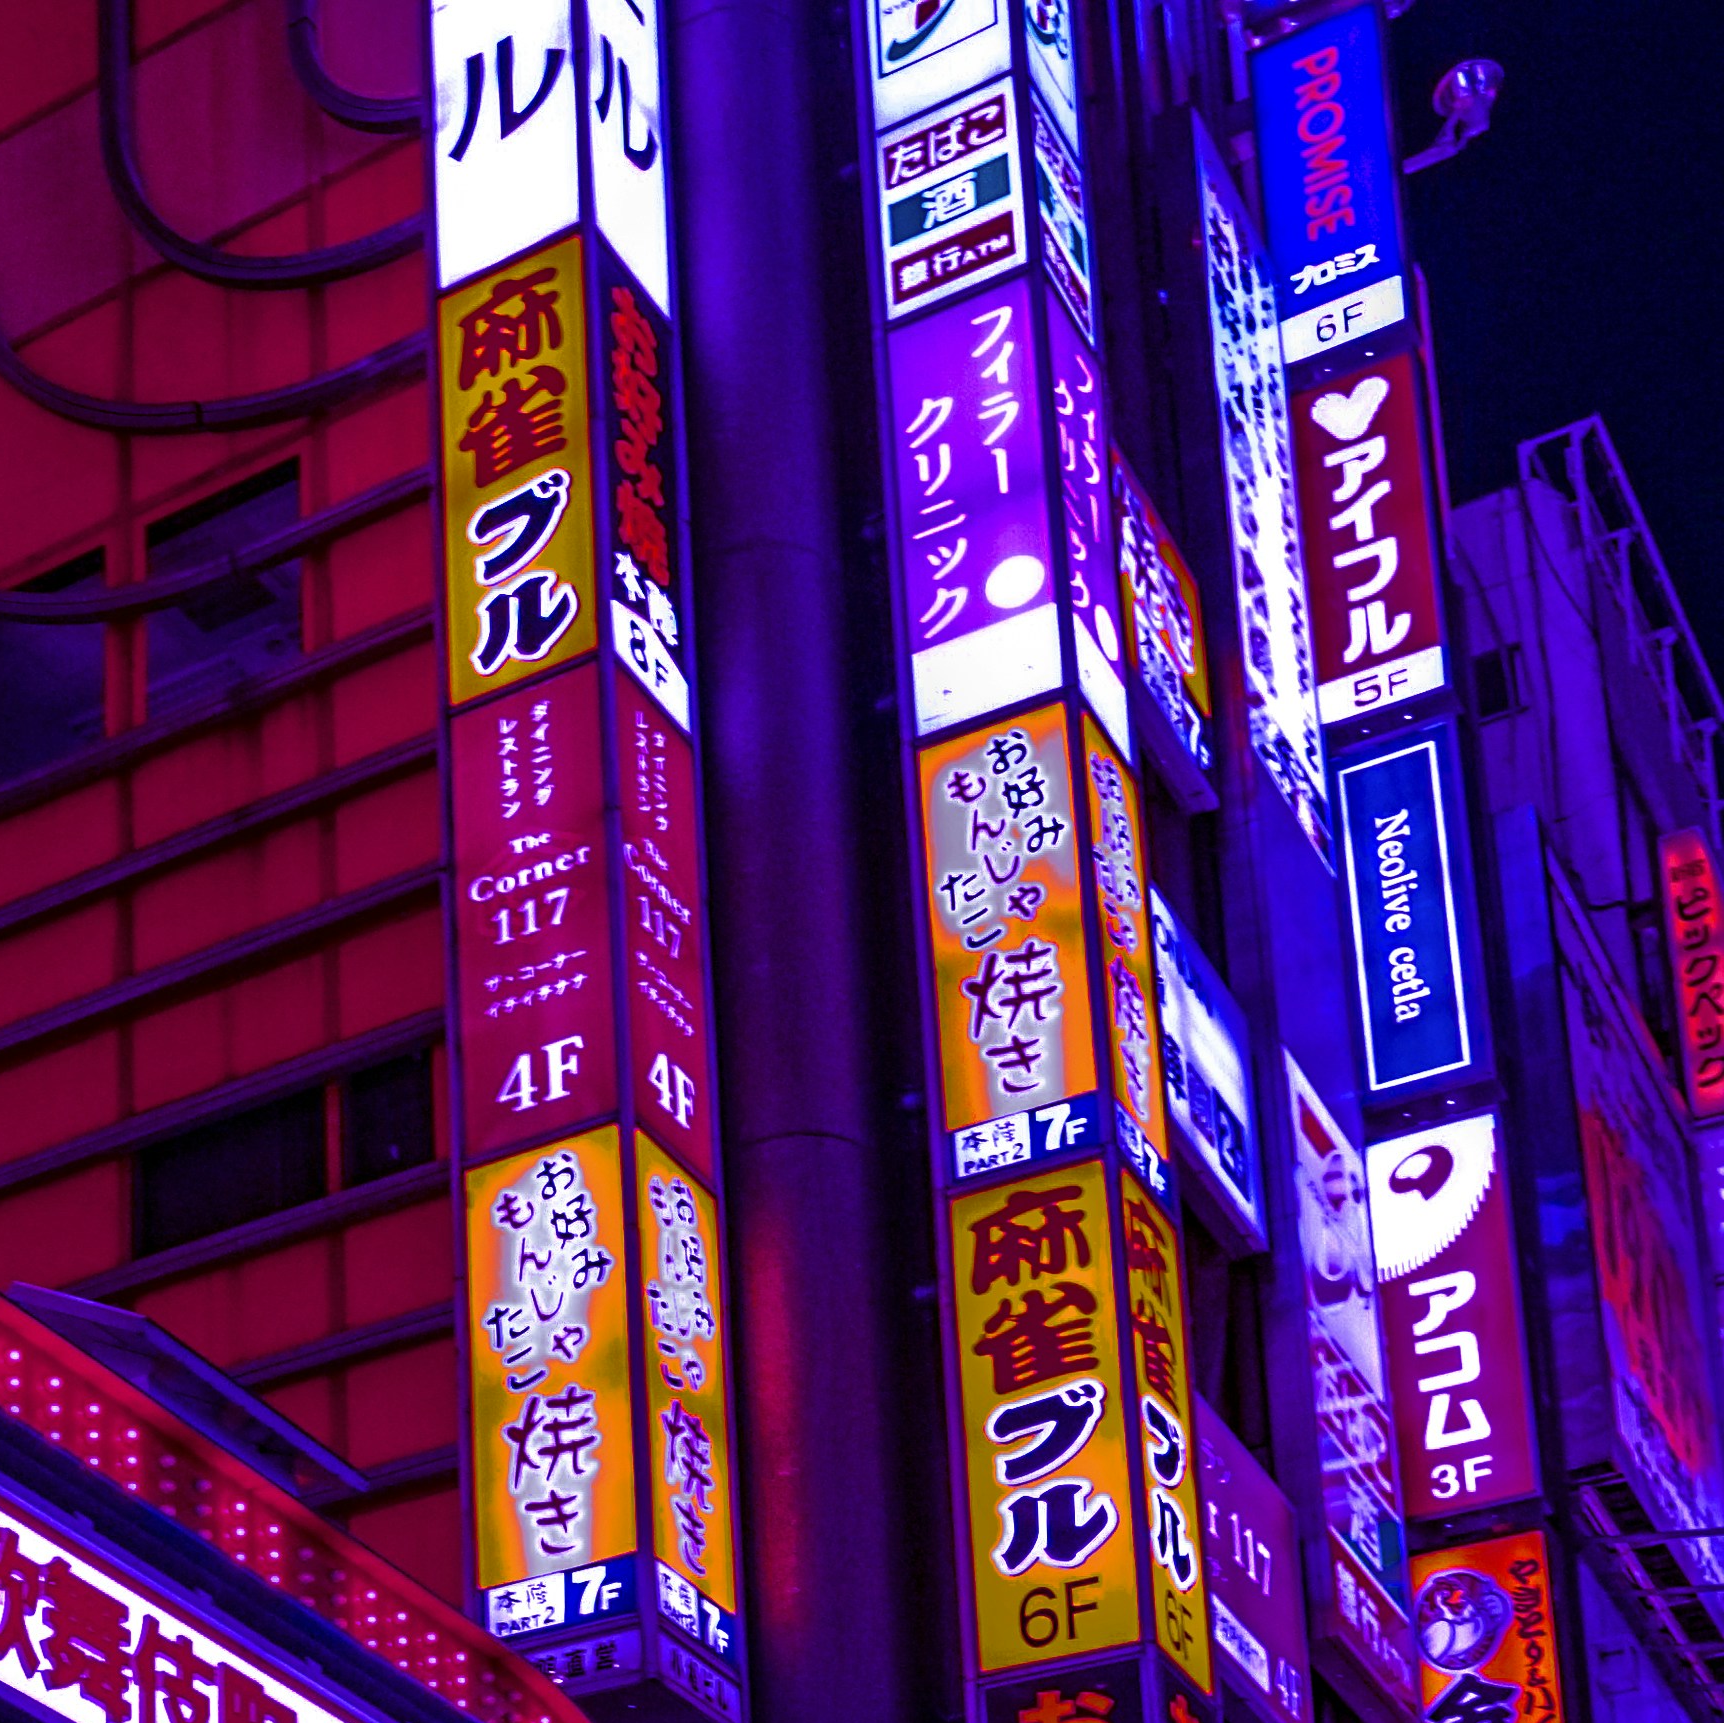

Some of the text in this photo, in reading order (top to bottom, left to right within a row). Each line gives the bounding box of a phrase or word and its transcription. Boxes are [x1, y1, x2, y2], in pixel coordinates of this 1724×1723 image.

[448, 36, 564, 162] ル
[889, 105, 1003, 186] たばこ
[1293, 45, 1355, 241] PROMISE
[922, 172, 977, 229] 酒
[899, 235, 1009, 291] 銀行ATM
[1291, 242, 1380, 296] プロミス
[1314, 302, 1366, 343] 6F
[969, 306, 1014, 496] フィラー
[457, 266, 578, 676] 麻雀ブル
[905, 395, 969, 640] クリニック
[1323, 434, 1412, 664] アイフル
[628, 619, 671, 689] 8F
[1354, 667, 1408, 707] 5F
[498, 718, 522, 820] レストラン
[530, 701, 554, 808] ダイニング
[985, 732, 1065, 852] お好み
[468, 845, 591, 902] Corner
[509, 832, 552, 855] The
[947, 770, 1042, 920] もんじゃ
[492, 888, 570, 945] 117
[639, 896, 682, 959] 117
[940, 873, 1003, 951] たこ
[1374, 809, 1432, 1024] Neolive cetla
[964, 942, 1058, 1095] 焼き
[495, 1036, 585, 1113] 4F
[649, 1052, 695, 1129] 4F
[1034, 1103, 1087, 1152] 7F
[538, 1154, 612, 1290] お好み
[497, 1193, 585, 1360] もんじゃ
[487, 1306, 546, 1390] たこ
[971, 1185, 1120, 1577] 麻雀ブル
[1408, 1270, 1491, 1452] アコム
[510, 1386, 595, 1556] 焼き
[1429, 1456, 1494, 1500] 3F
[572, 1566, 622, 1615] 7F
[701, 1597, 729, 1653] 7F
[1019, 1576, 1100, 1649] 6F
